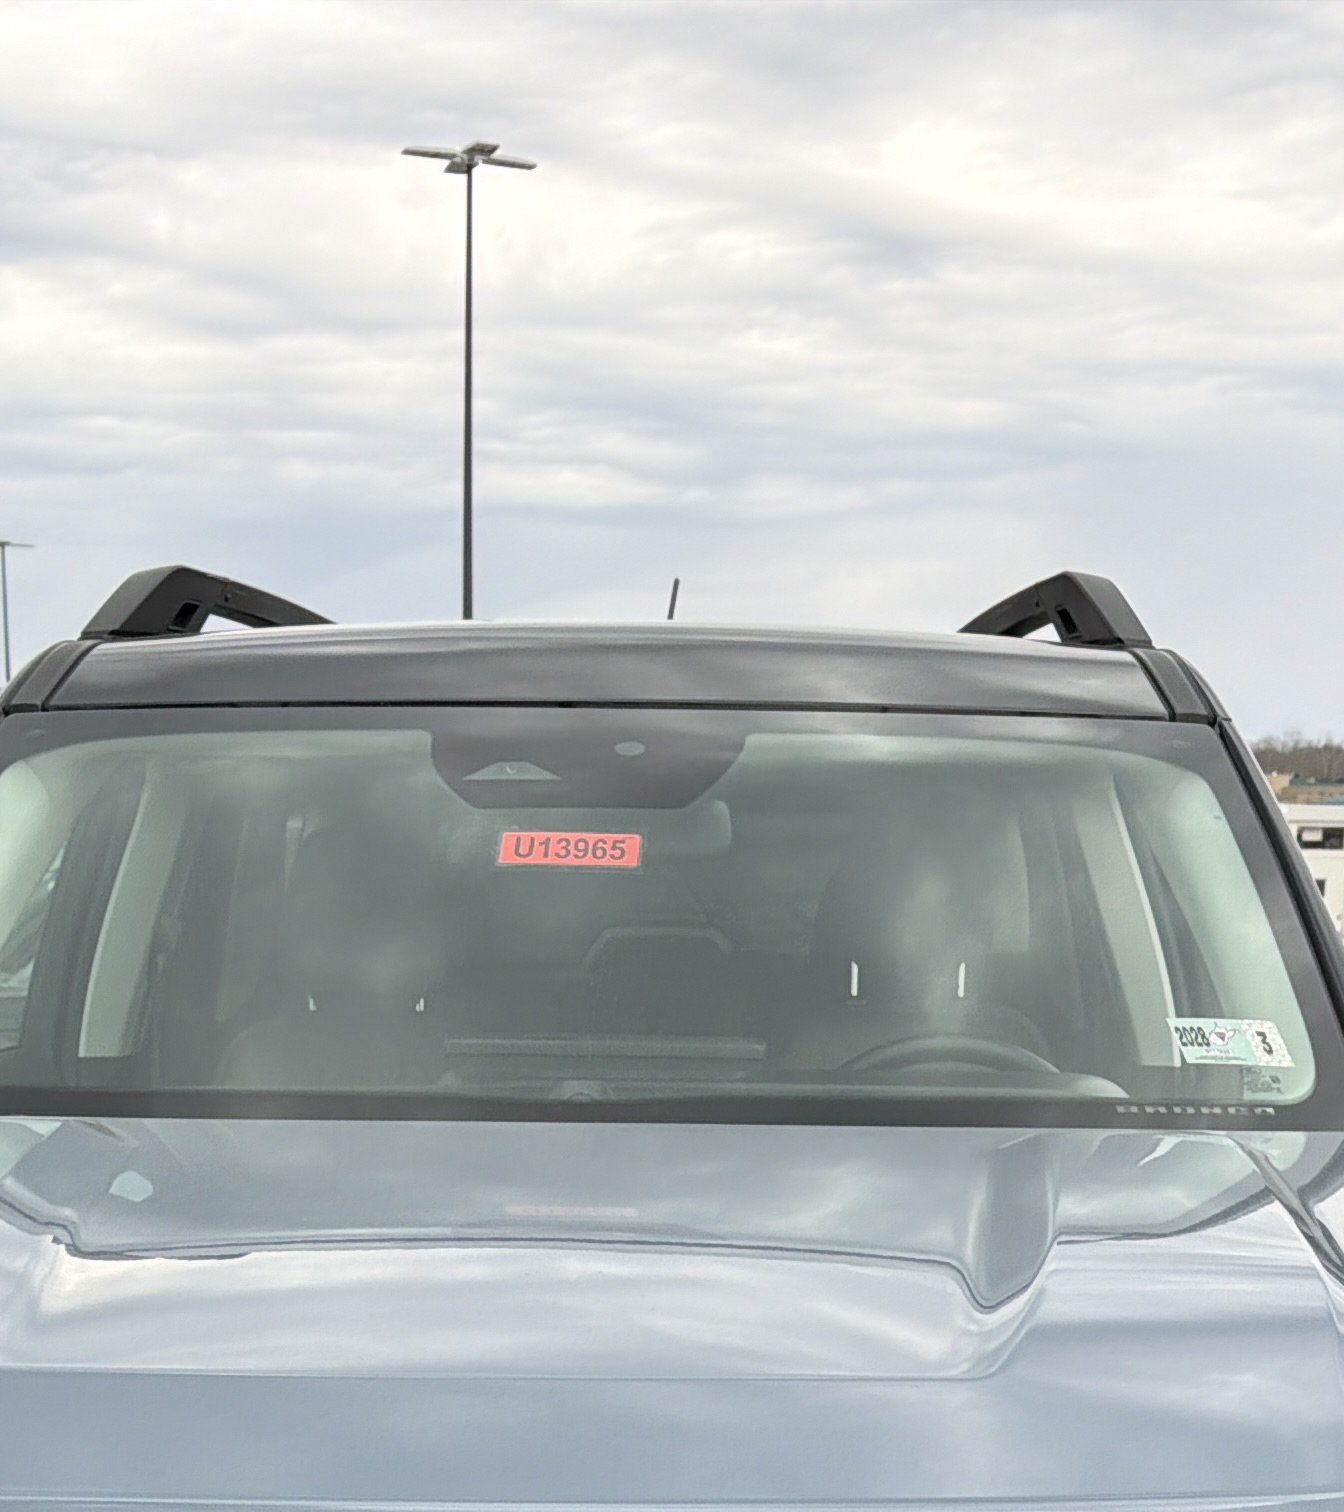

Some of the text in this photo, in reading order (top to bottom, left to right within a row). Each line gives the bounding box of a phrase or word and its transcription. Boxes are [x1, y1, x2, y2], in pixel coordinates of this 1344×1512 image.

[513, 836, 626, 860] U13965
[1174, 1026, 1274, 1056] 2028 3
